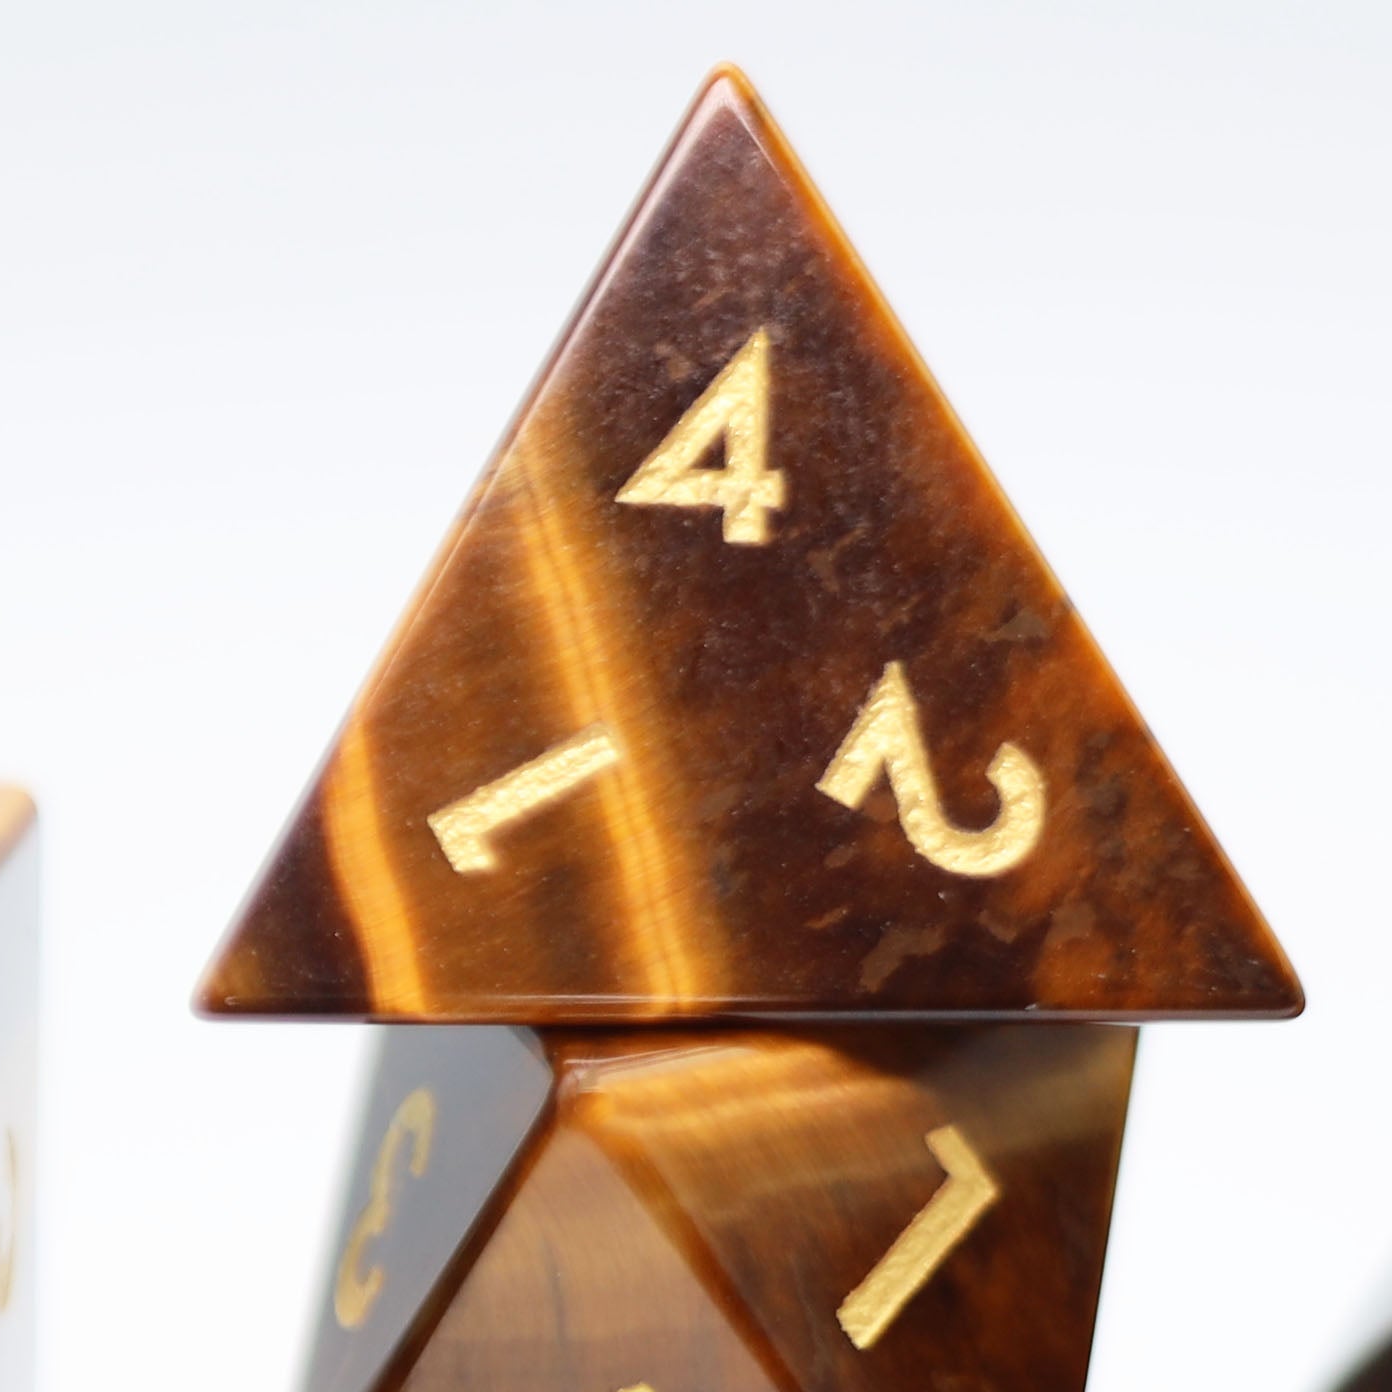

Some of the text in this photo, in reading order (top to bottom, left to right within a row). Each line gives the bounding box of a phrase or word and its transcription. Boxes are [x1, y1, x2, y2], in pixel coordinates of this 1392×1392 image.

[614, 327, 785, 545] 4
[427, 722, 620, 875] 1
[814, 659, 1045, 877] 2
[836, 1124, 998, 1351] 1
